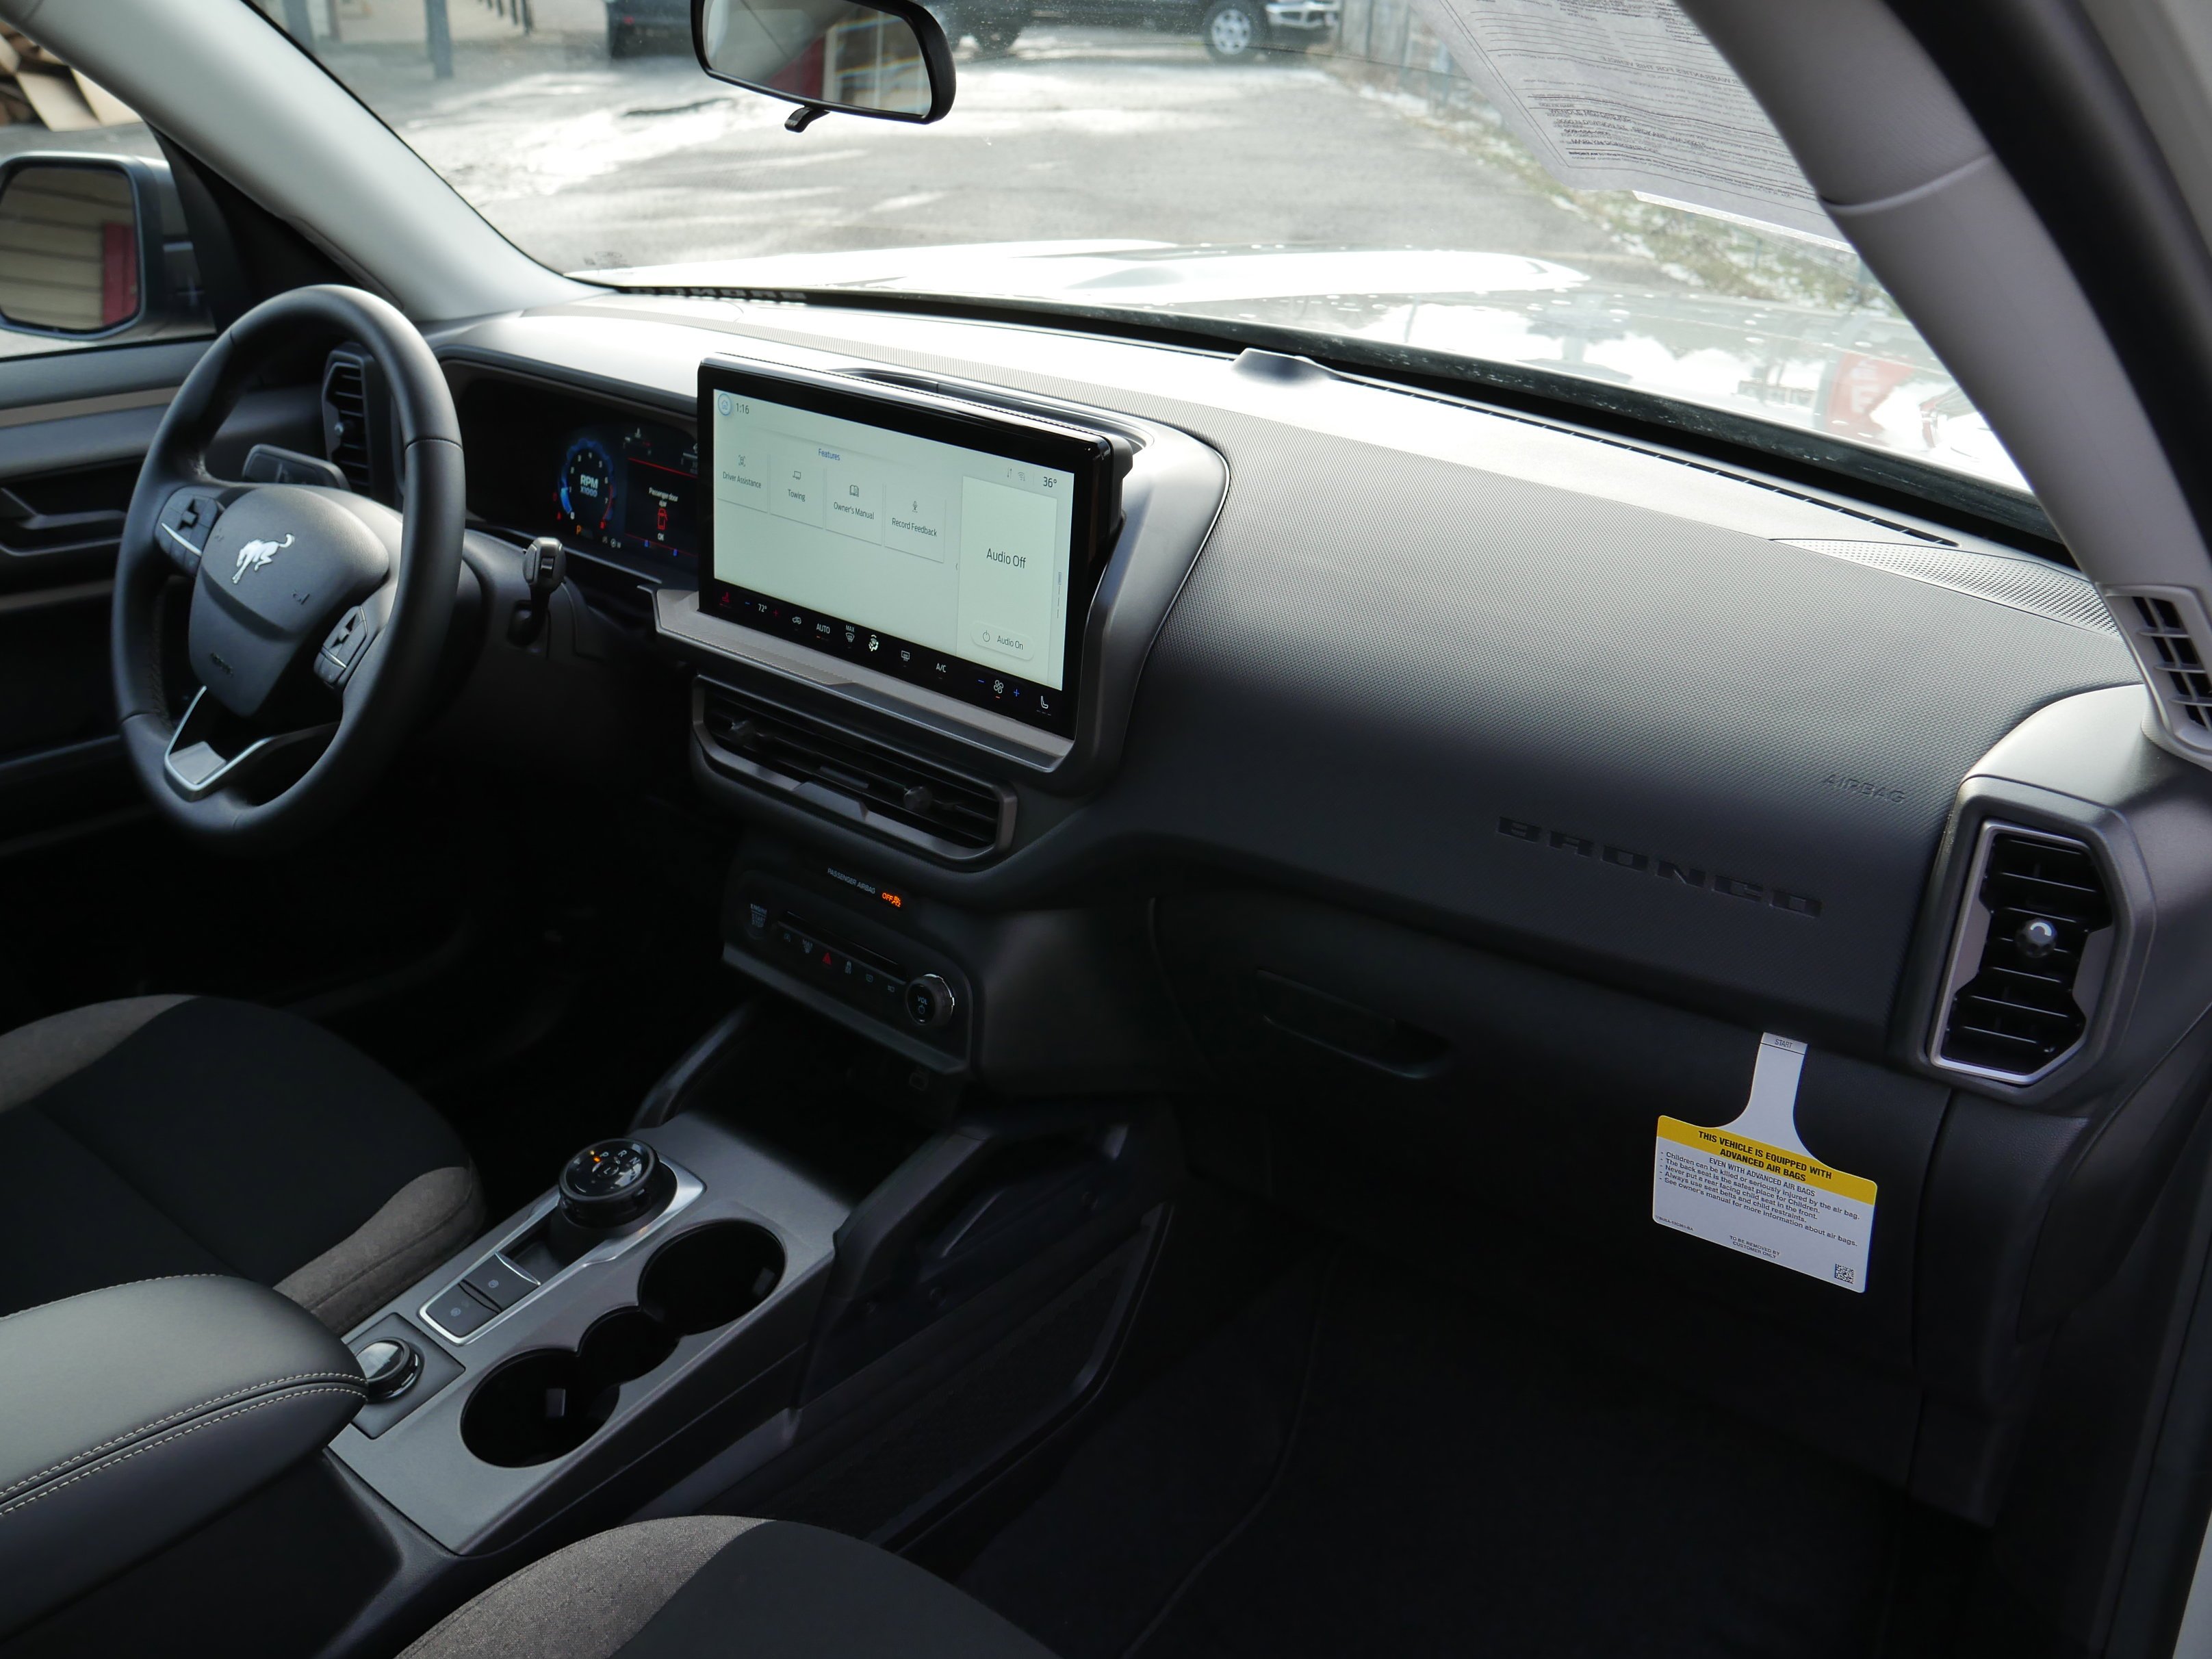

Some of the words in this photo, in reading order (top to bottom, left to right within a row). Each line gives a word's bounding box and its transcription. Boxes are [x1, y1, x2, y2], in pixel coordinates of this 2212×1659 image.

[736, 402, 749, 415] 1:16
[818, 448, 840, 461] Features
[580, 474, 599, 489] RPM
[723, 471, 737, 483] Driver
[737, 475, 761, 489] Assistance
[1042, 476, 1057, 489] 36°
[788, 489, 806, 502] Towing
[833, 501, 853, 515] Owner's
[854, 507, 873, 520] Manual
[891, 517, 910, 530] Record
[911, 522, 937, 537] Feedback
[986, 548, 1010, 565] Audio
[1012, 554, 1025, 569] Off
[816, 622, 830, 634] AUTO
[845, 624, 855, 632] MAX
[996, 634, 1013, 647] Audio
[1014, 640, 1023, 650] On
[936, 663, 947, 673] A/C
[1825, 774, 1905, 804] AIRBAG
[1495, 815, 1823, 918] BRONCO
[827, 868, 857, 886] PASSENGER
[857, 882, 875, 895] AIRBAG
[882, 892, 894, 902] OFF
[917, 994, 927, 1005] VOL
[1775, 1038, 1793, 1049] START
[629, 1157, 641, 1165] N
[1698, 1130, 1716, 1143] THIS
[1719, 1137, 1753, 1154] VEHICLE
[1755, 1148, 1763, 1157] IS
[1765, 1152, 1807, 1172] EQUIPPED
[1809, 1166, 1831, 1179] WITH
[1720, 1148, 1764, 1168] ADVANCED
[1766, 1163, 1781, 1174] AIR
[1783, 1168, 1805, 1181] BAGS
[1666, 1151, 1694, 1166] Children
[1719, 1168, 1738, 1179] killed
[1749, 1179, 1780, 1194] seriously
[1782, 1189, 1807, 1203] injured
[1809, 1198, 1817, 1207] by
[1819, 1201, 1831, 1210] the
[1833, 1205, 1842, 1213] air
[1844, 1209, 1860, 1220] bag.
[1666, 1158, 1677, 1167] The
[1680, 1162, 1695, 1172] back
[1697, 1168, 1711, 1178] seat
[1721, 1176, 1732, 1184] the
[1733, 1180, 1754, 1192] safest
[1756, 1187, 1775, 1199] place
[1776, 1194, 1786, 1203] for
[1788, 1198, 1820, 1213] Children.
[1709, 1157, 1726, 1168] EVEN
[1727, 1163, 1745, 1174] WITH
[1747, 1169, 1782, 1186] ADVANCED
[1783, 1181, 1795, 1190] AIR
[1797, 1185, 1815, 1196] BAGS
[1664, 1171, 1688, 1185] Always
[1704, 1184, 1718, 1194] seat
[1720, 1189, 1736, 1199] belts
[1738, 1195, 1751, 1205] and
[1753, 1200, 1769, 1210] child
[1771, 1206, 1807, 1223] restraints.
[1665, 1164, 1684, 1175] Never
[1686, 1172, 1697, 1181] put
[1704, 1179, 1718, 1187] rear
[1719, 1182, 1740, 1196] facing
[1742, 1189, 1759, 1200] child
[1761, 1196, 1775, 1205] seat
[1786, 1204, 1797, 1212] the
[1798, 1208, 1818, 1220] front.
[1664, 1177, 1677, 1186] See
[1678, 1182, 1704, 1196] owner's
[1706, 1191, 1731, 1205] manual
[1732, 1200, 1742, 1208] for
[1743, 1205, 1761, 1214] more
[1763, 1210, 1803, 1229] information
[1805, 1224, 1825, 1235] about
[1827, 1231, 1836, 1239] air
[1838, 1235, 1857, 1248] bags.
[1732, 1241, 1761, 1254] CUSTOMER
[1763, 1251, 1776, 1259] ONLY
[1748, 1242, 1771, 1252] REMOVED
